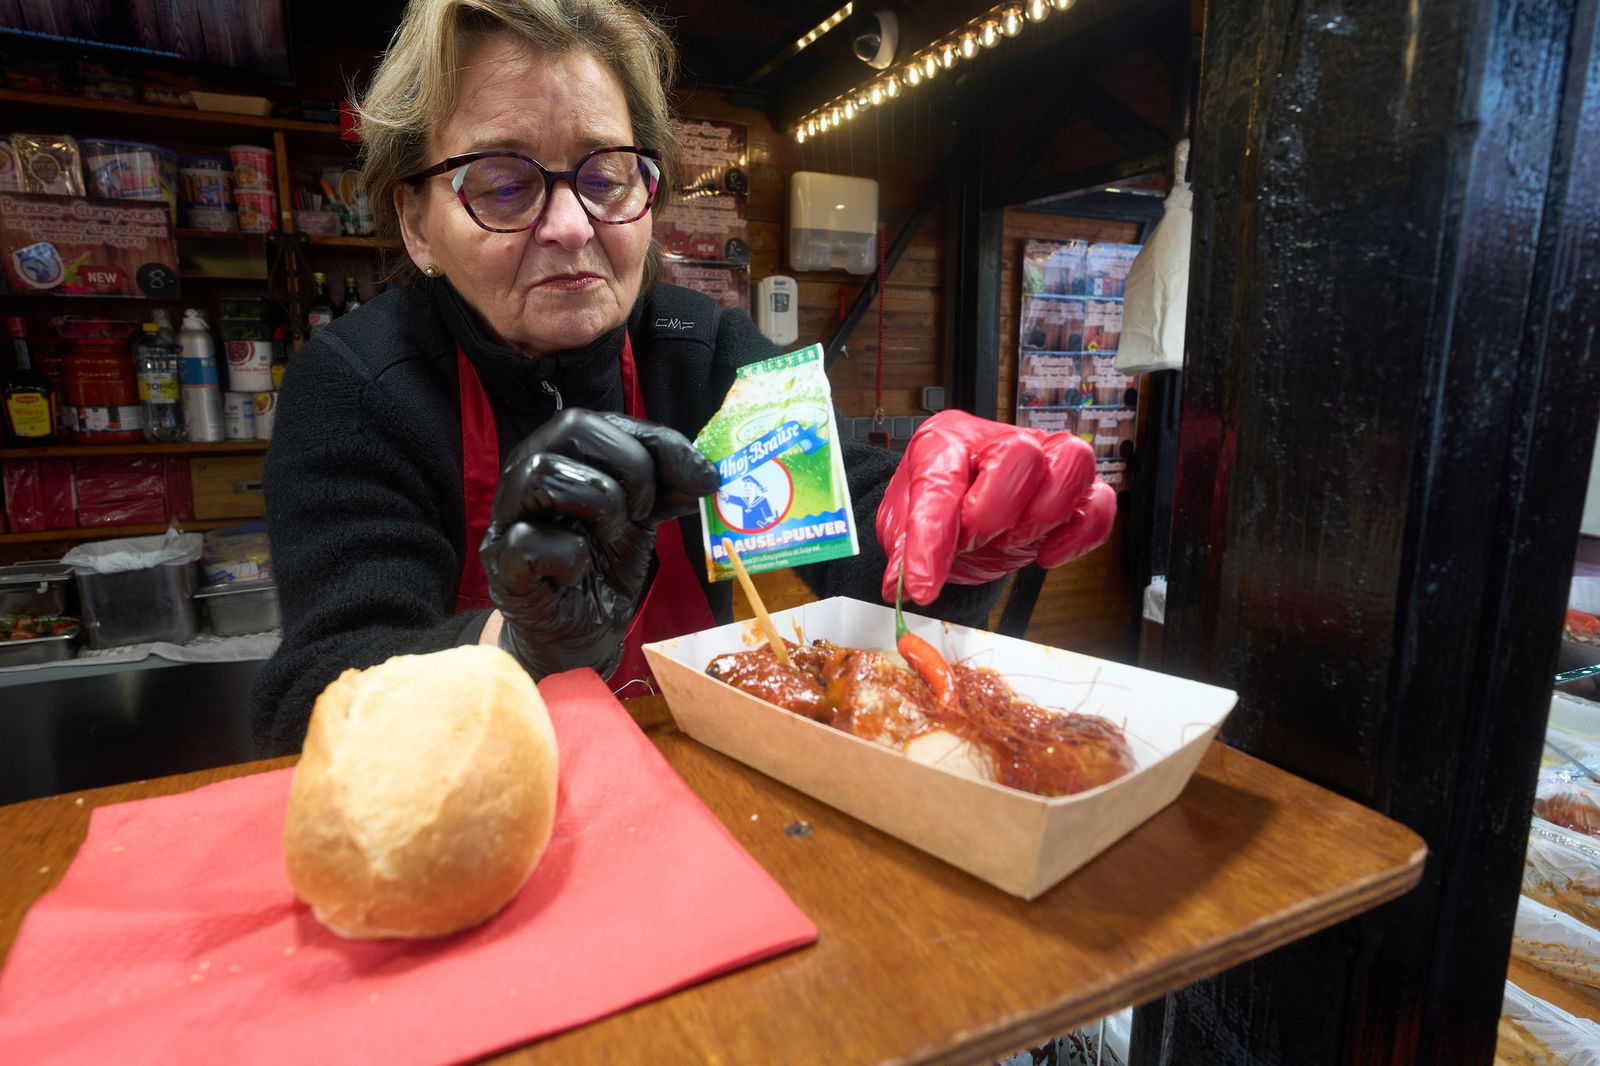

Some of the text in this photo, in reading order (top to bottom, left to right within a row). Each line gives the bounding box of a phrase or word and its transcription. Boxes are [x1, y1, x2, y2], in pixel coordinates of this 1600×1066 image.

[3, 201, 59, 214] Brause
[74, 203, 165, 222] Currywurst
[88, 272, 116, 284] NEW
[656, 318, 695, 330] CMP
[145, 382, 175, 391] TONIC
[719, 424, 799, 479] Ahoj-Brause
[713, 520, 848, 559] BAUSE-PULVER
